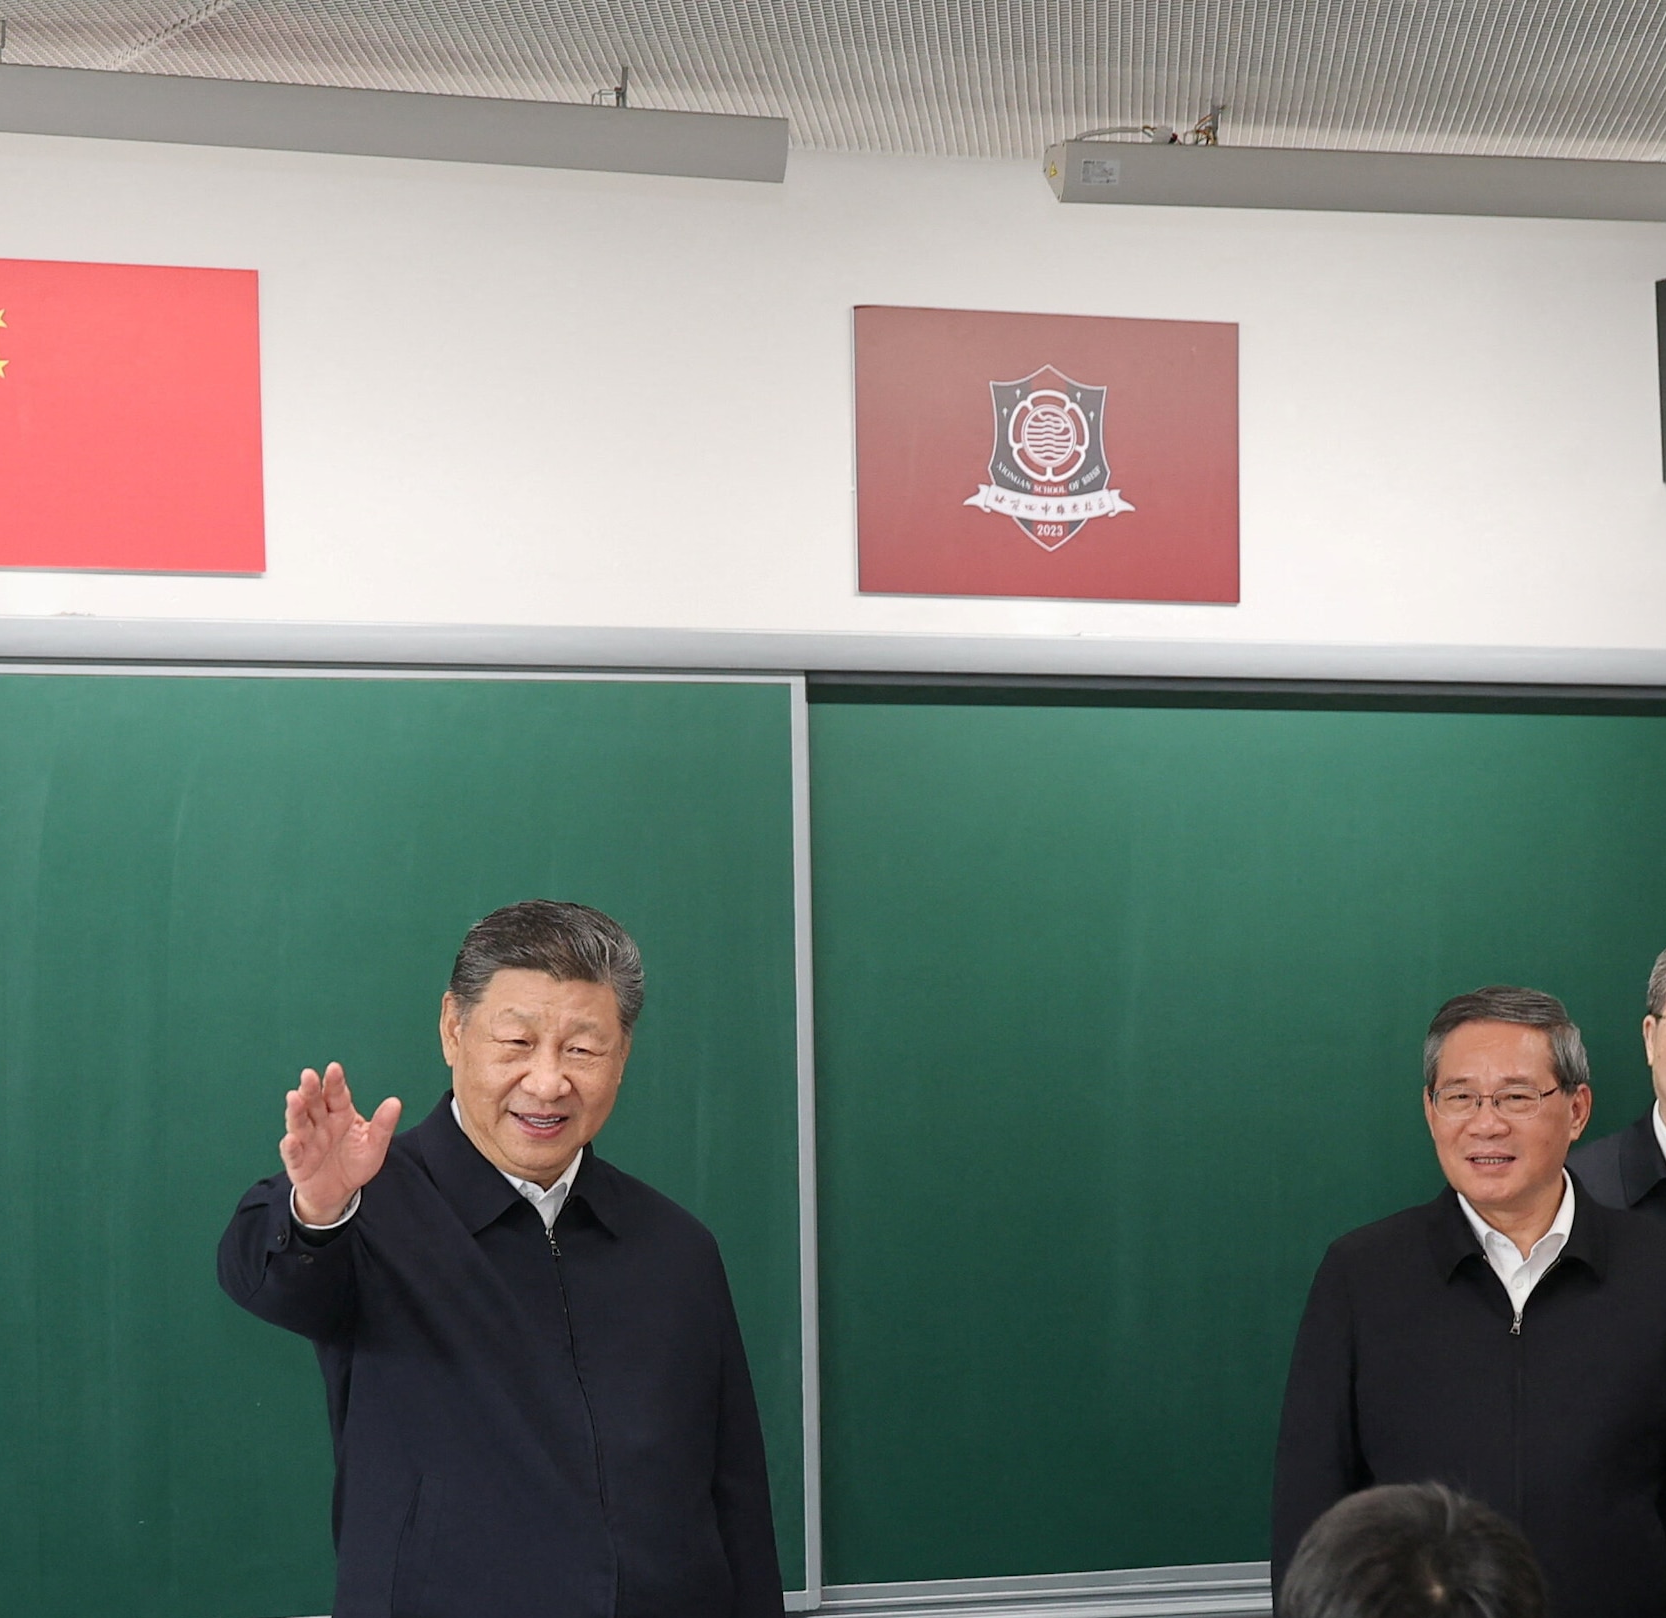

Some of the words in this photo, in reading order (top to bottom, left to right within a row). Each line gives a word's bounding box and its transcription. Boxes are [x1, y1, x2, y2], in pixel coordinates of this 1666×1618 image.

[996, 461, 1031, 491] XIONGAN
[1033, 485, 1067, 494] SCHOOL
[1069, 480, 1080, 492] OF
[1037, 524, 1064, 536] 2023
